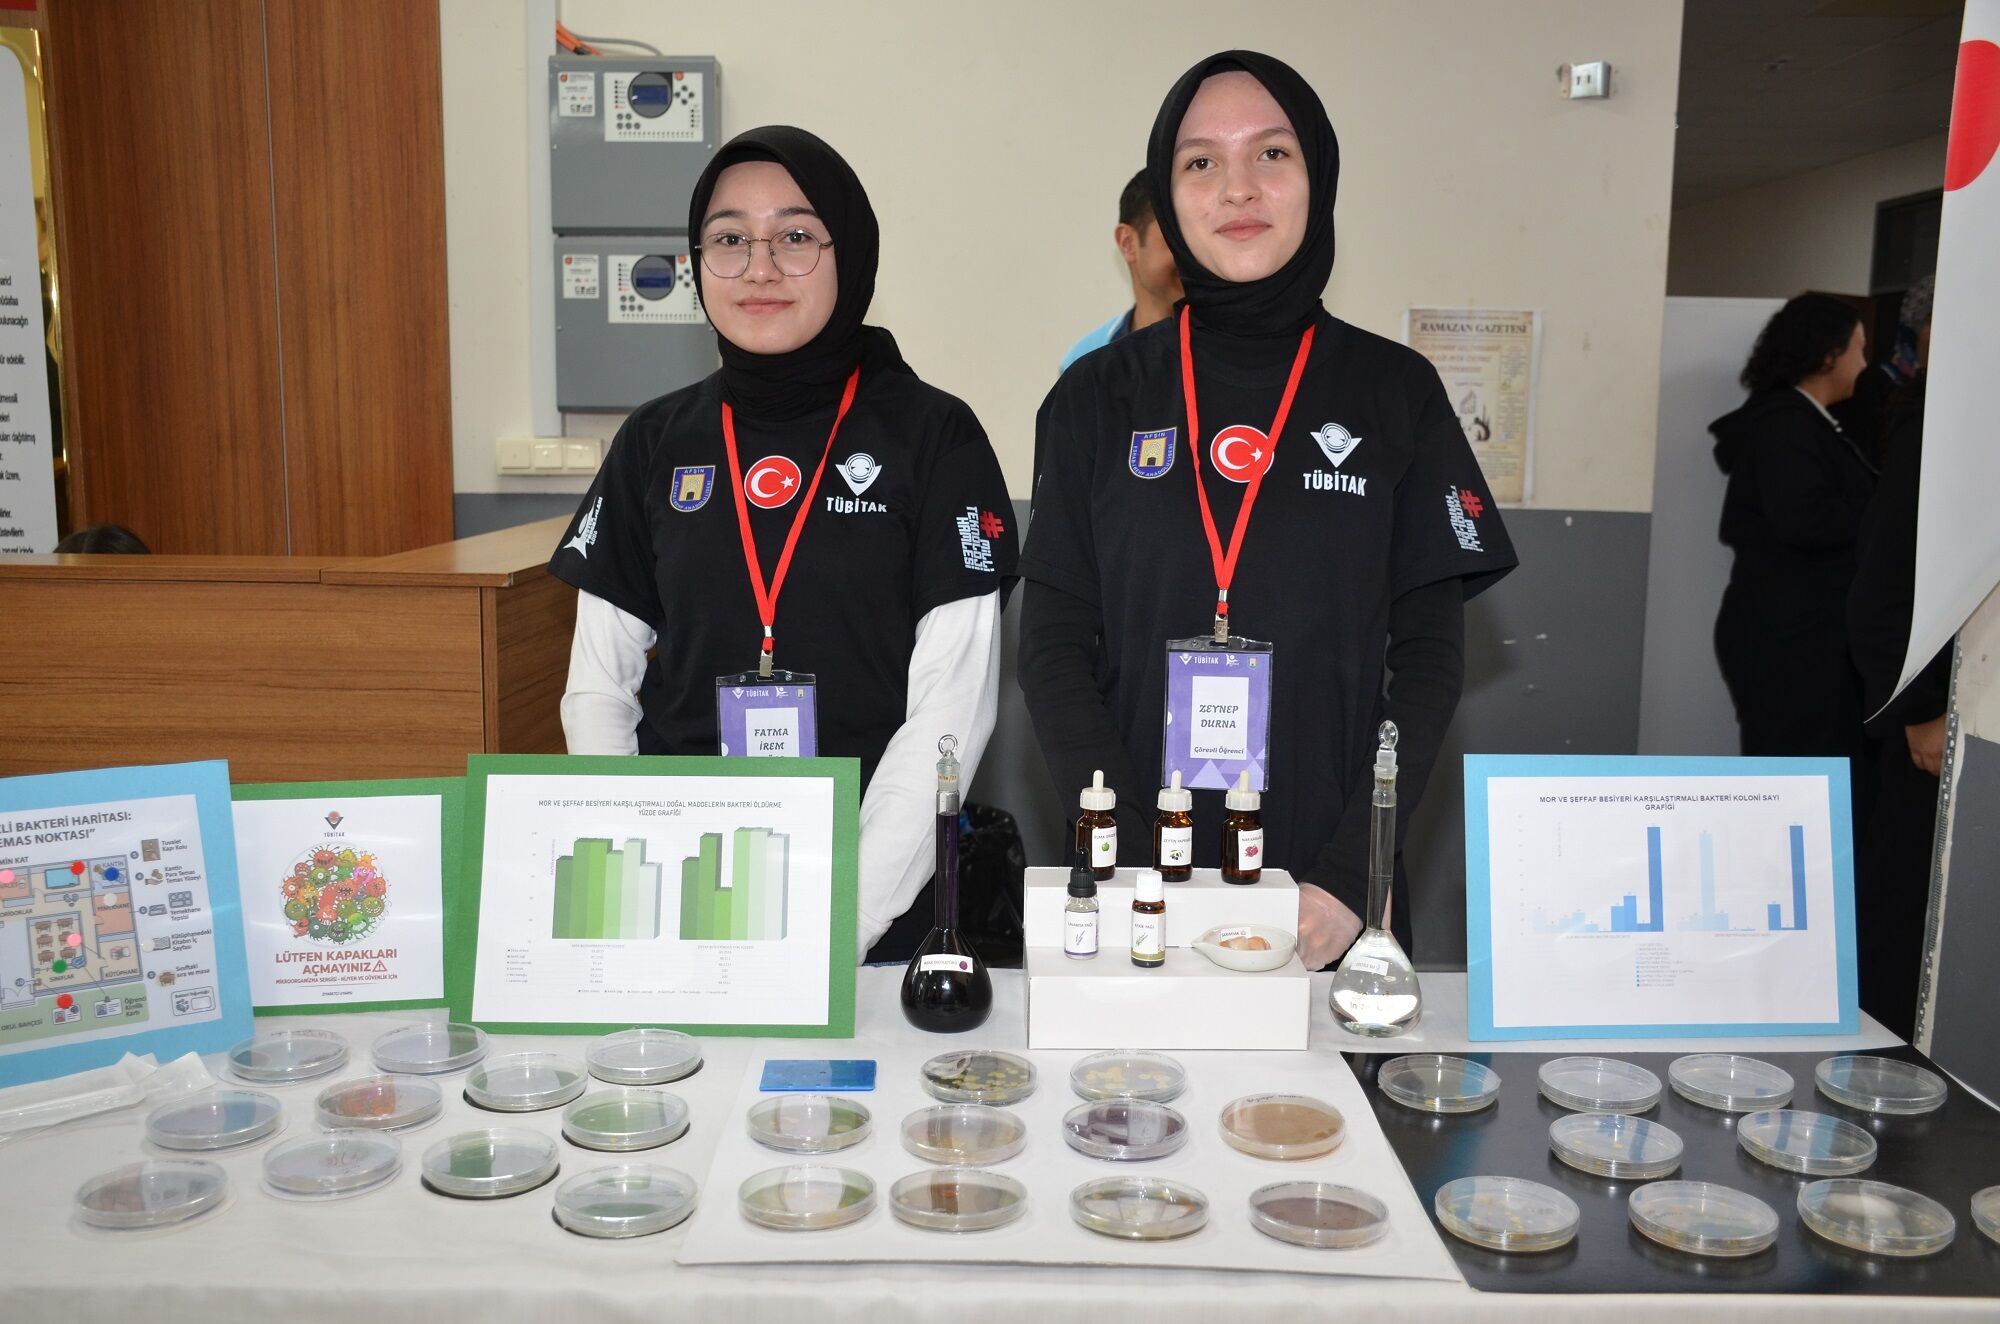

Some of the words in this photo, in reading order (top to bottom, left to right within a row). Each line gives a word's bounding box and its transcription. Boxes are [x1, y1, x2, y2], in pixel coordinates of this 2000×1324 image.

[1420, 322, 1472, 332] RAMAZAN
[1302, 469, 1367, 497] TÜBİTAK
[826, 496, 888, 514] TÜBİTAK
[956, 516, 975, 570] HAMLESİ
[1194, 655, 1219, 665] TÜBİTAK
[746, 688, 770, 698] TÜBİTAK
[1199, 704, 1239, 714] ZEYNEP
[1200, 719, 1237, 729] DURNA
[754, 728, 789, 737] FATMA
[759, 741, 785, 751] İREM
[1194, 746, 1218, 754] Görevli
[1218, 745, 1244, 755] Öğrenci
[1569, 796, 1597, 804] ŞEFFAF
[1599, 794, 1632, 803] BESİYERİ
[1633, 795, 1699, 803] KARŞILAŞTIRMALI
[1700, 794, 1732, 802] BAKTERİ
[1733, 793, 1761, 801] KOLONİ
[538, 799, 552, 807] MOR
[562, 800, 585, 808] ŞEFFAF
[585, 799, 612, 808] BESİYERİ
[613, 800, 666, 809] KARŞILAŞTIRMALI
[666, 800, 686, 808] DOĞAL
[687, 800, 726, 808] MADDELERİN
[727, 800, 753, 808] BAKTERİ
[753, 801, 782, 809] ÖLDÜRME
[638, 809, 657, 817] YÜZDE
[16, 815, 69, 833] BAKTERİ
[72, 811, 132, 827] HARİTASI:
[14, 856, 30, 865] KAT
[275, 950, 323, 964] LÜTFEN
[326, 948, 397, 961] KAPAKLARI
[302, 962, 372, 977] AÇMAYINIZ
